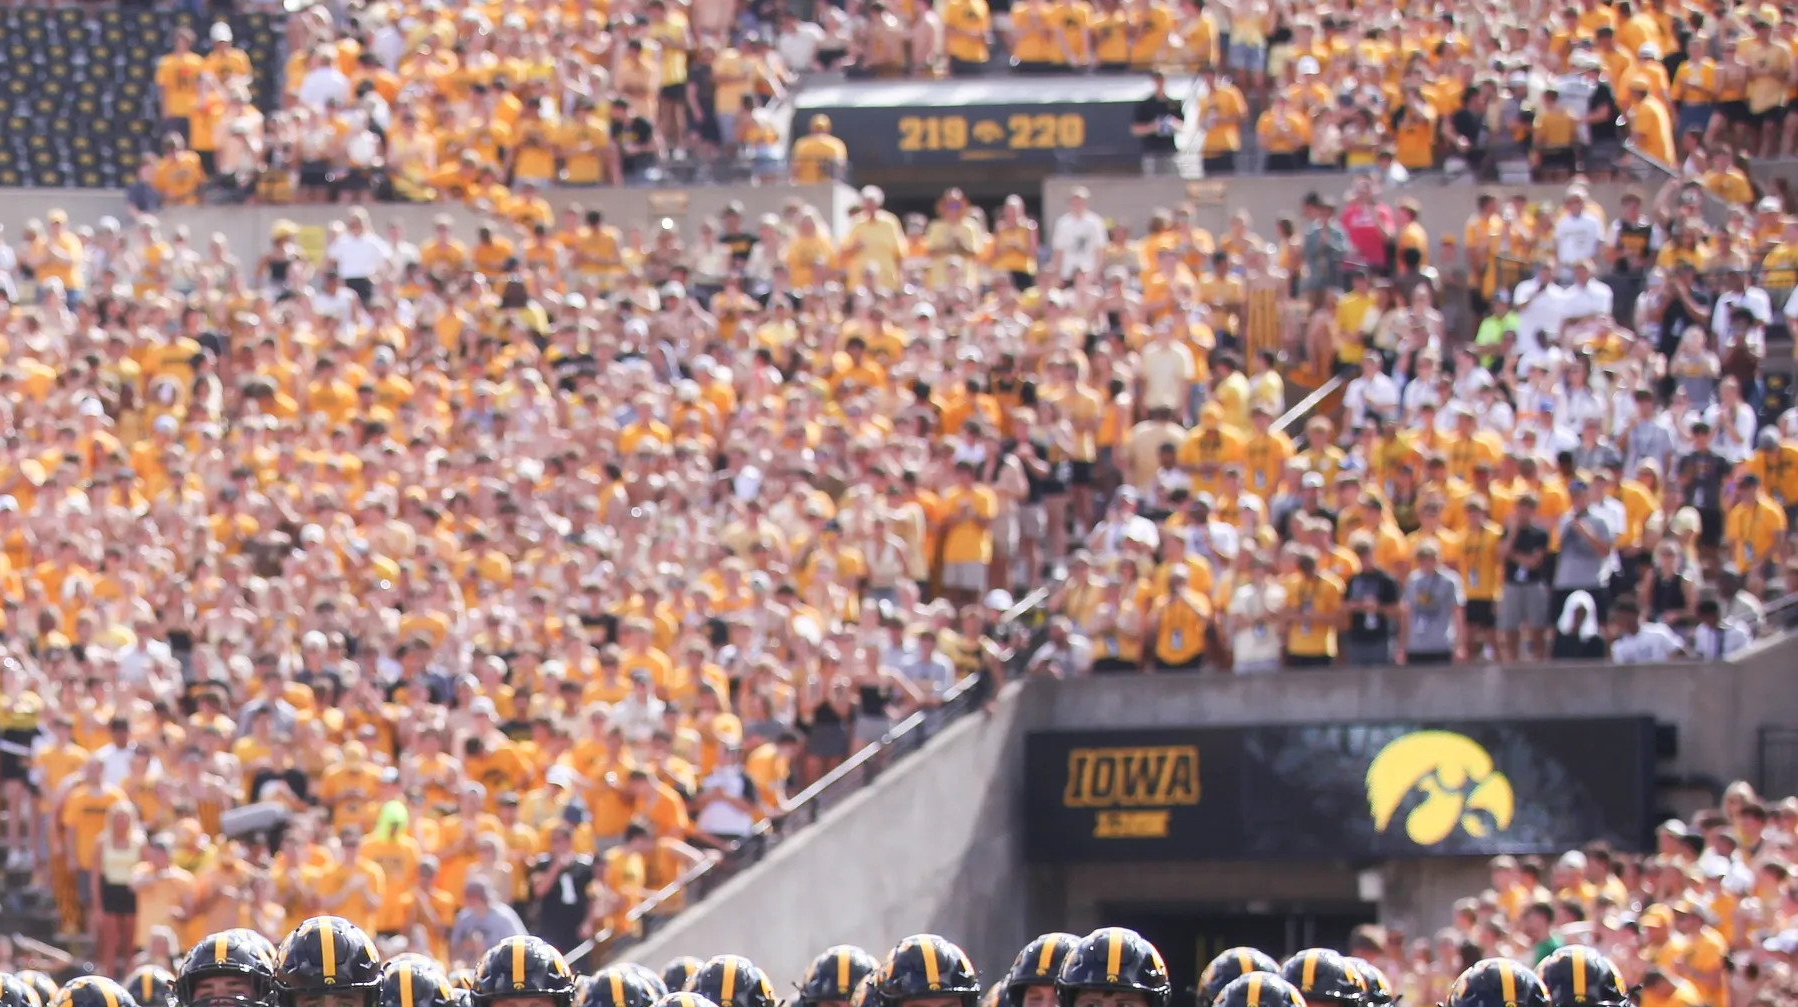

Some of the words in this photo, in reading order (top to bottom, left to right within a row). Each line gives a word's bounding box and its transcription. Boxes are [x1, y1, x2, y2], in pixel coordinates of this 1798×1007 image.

[899, 116, 967, 150] 219
[1009, 114, 1085, 148] 220
[1065, 747, 1200, 806] IOWA
